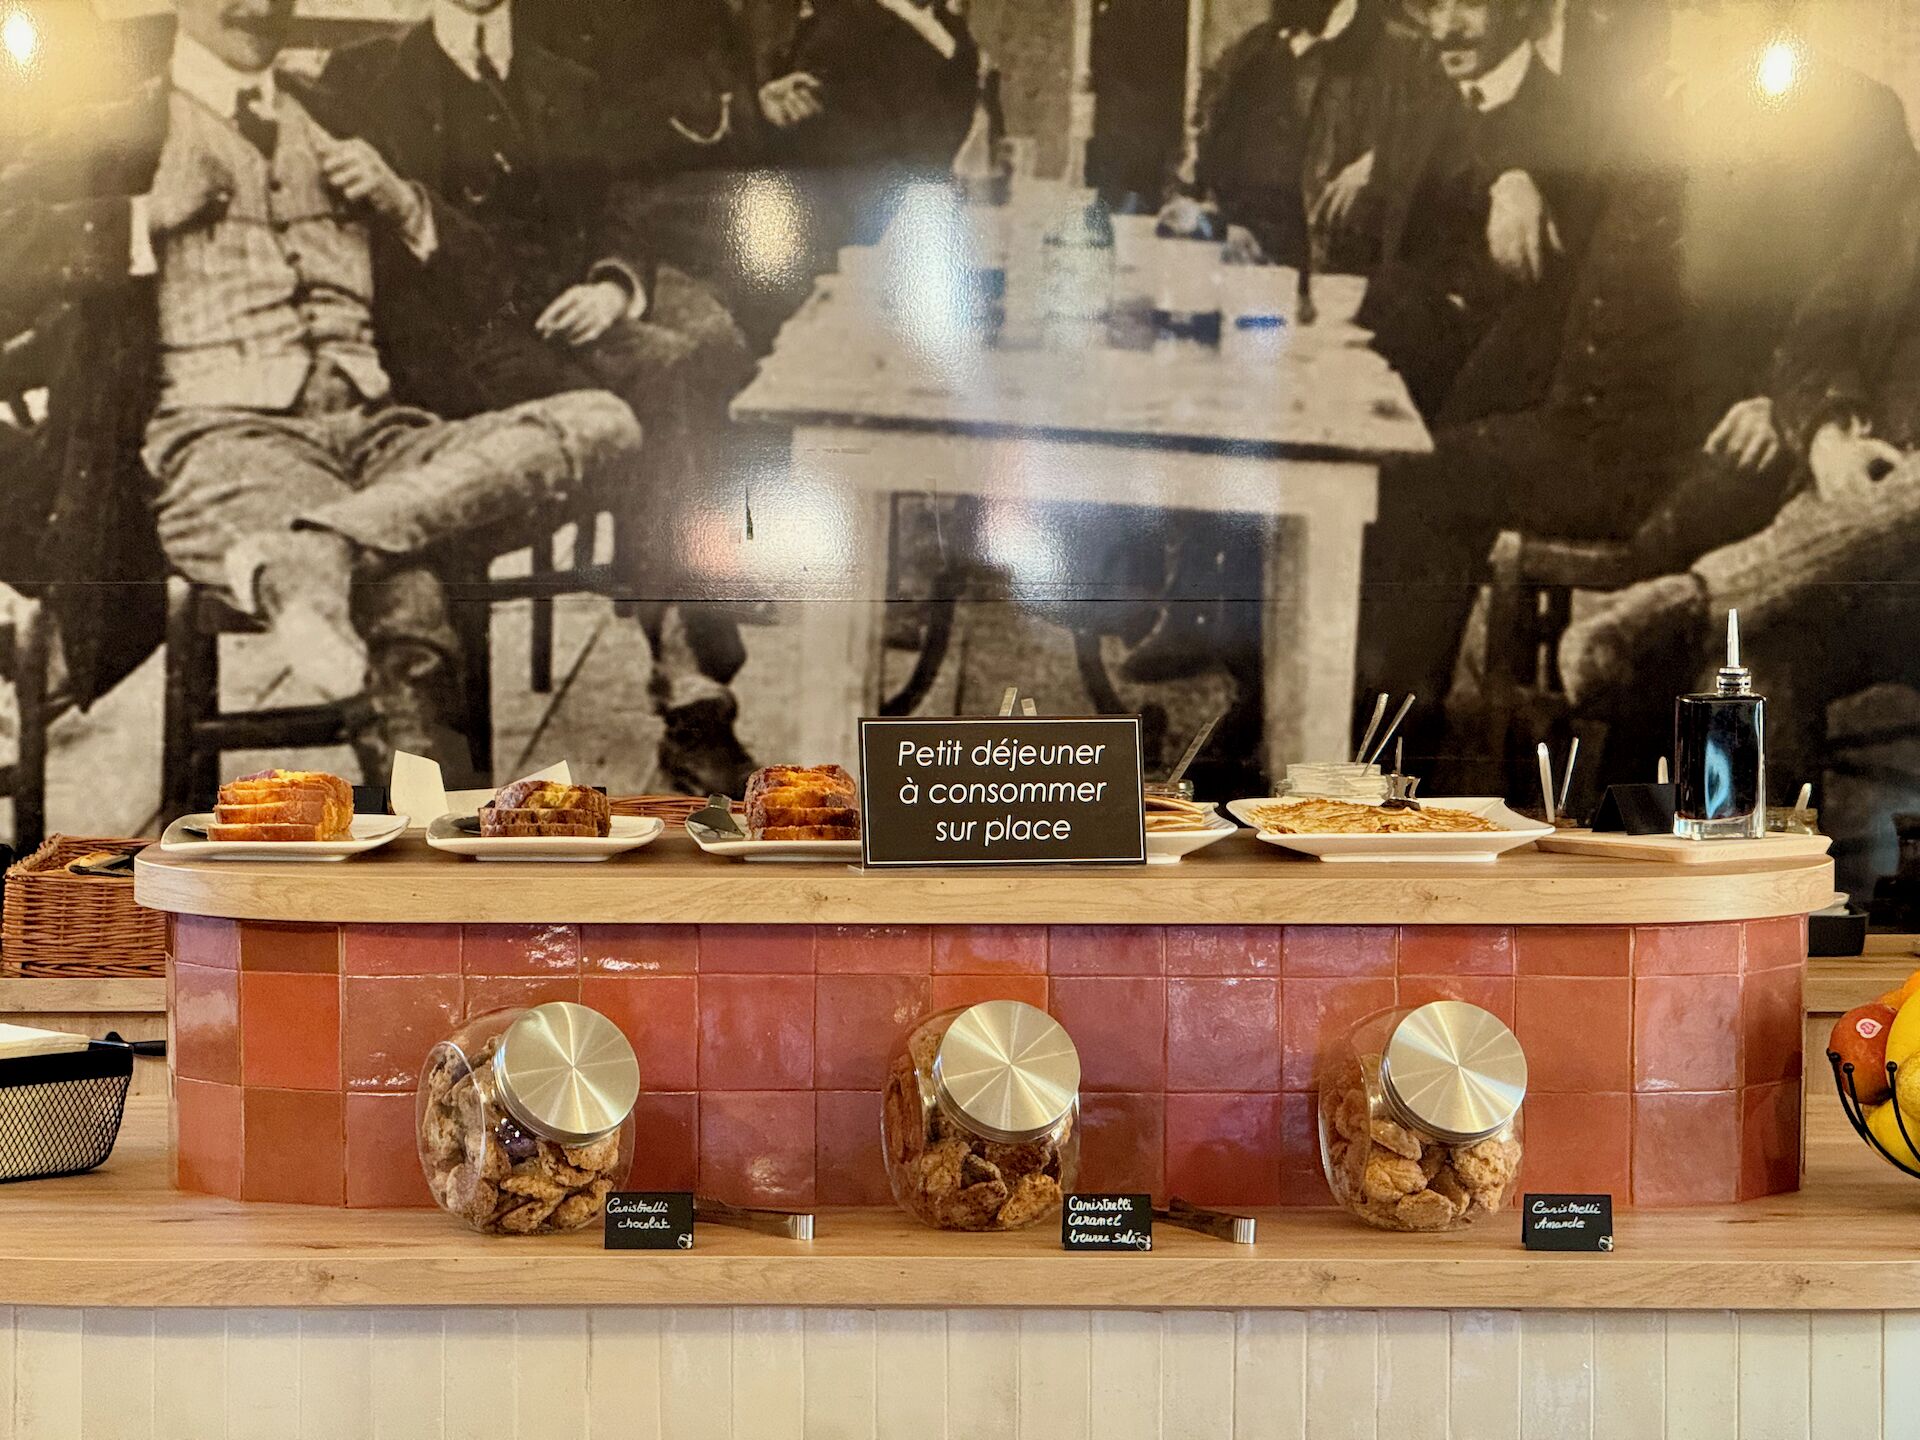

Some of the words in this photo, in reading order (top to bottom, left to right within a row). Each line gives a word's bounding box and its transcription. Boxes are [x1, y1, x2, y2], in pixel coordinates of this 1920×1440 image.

[897, 739, 963, 767] Petit
[971, 738, 1106, 772] déjeuner
[899, 777, 919, 805] à
[928, 780, 1108, 804] consommer
[935, 819, 978, 842] sur
[984, 814, 1072, 847] place
[617, 1216, 671, 1230] chocolat
[1067, 1212, 1123, 1227] Caramel
[1534, 1216, 1586, 1230] Amande
